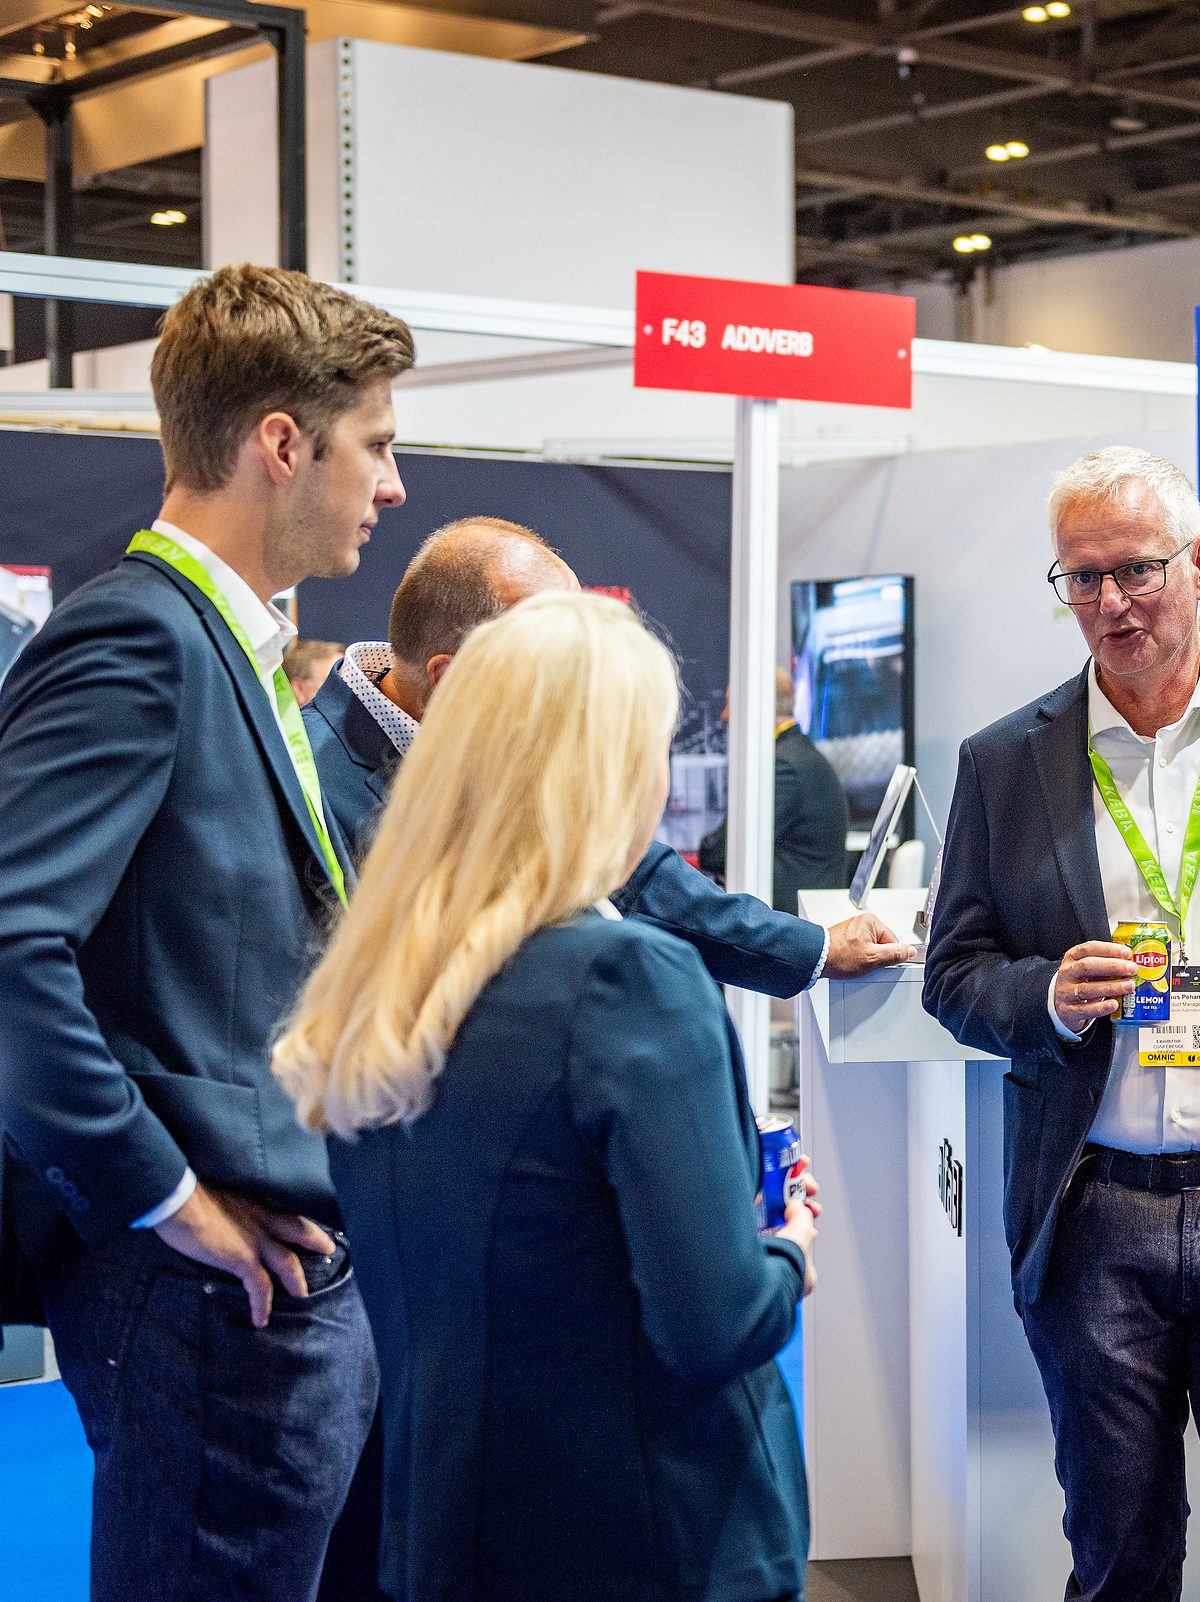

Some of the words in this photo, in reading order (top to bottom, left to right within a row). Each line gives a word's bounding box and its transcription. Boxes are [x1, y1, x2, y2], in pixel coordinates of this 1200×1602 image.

[662, 318, 706, 349] F43
[721, 324, 814, 357] ADDVERB
[1102, 783, 1135, 834] KEBA
[1180, 850, 1200, 908] KEBA
[1136, 954, 1166, 966] Lipton
[1136, 996, 1164, 1004] LEMON
[1147, 1053, 1176, 1061] OMNIC
